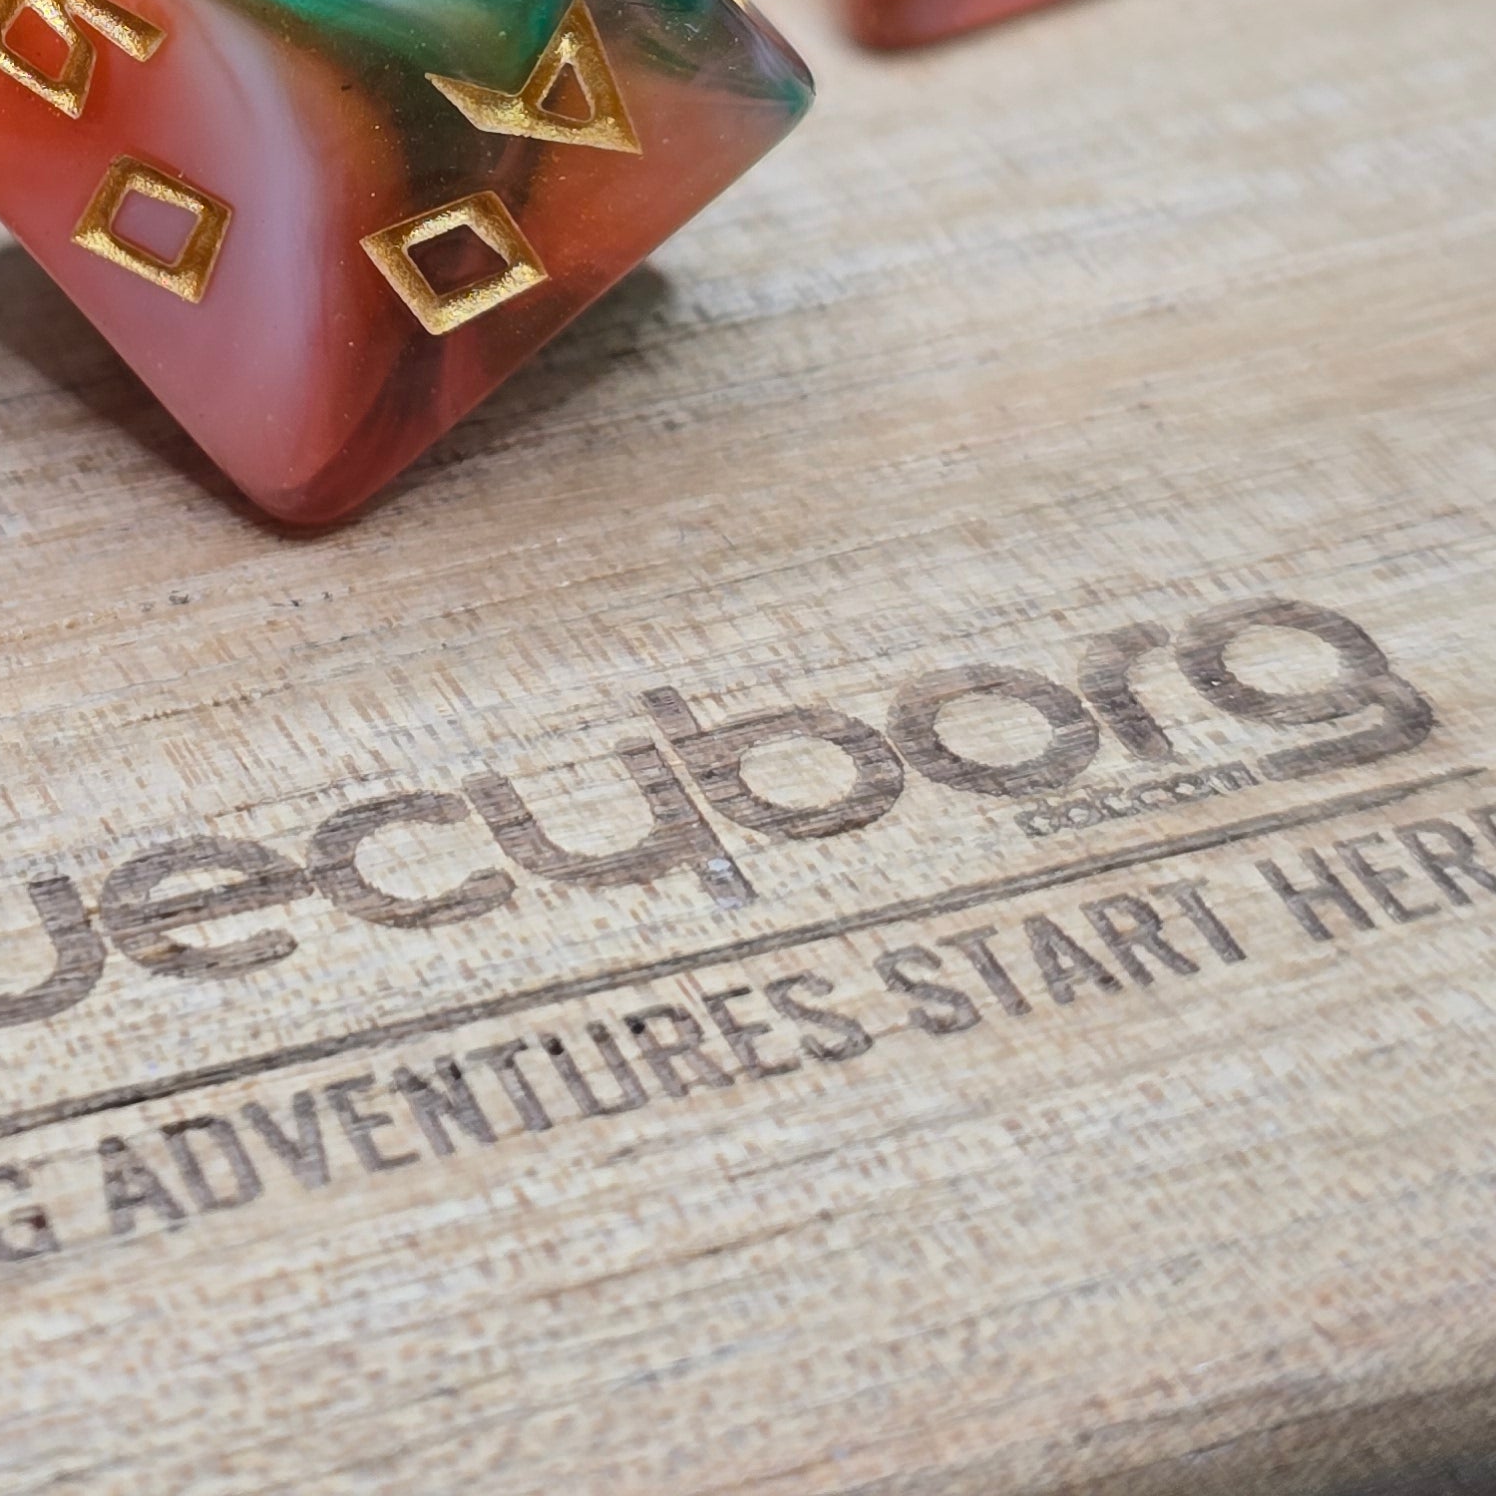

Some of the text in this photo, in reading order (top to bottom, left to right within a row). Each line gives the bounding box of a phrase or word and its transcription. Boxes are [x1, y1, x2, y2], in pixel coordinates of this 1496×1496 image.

[96, 970, 874, 1236] ADVENTURES
[874, 876, 1247, 1036] START
[1254, 804, 1496, 942] HER
